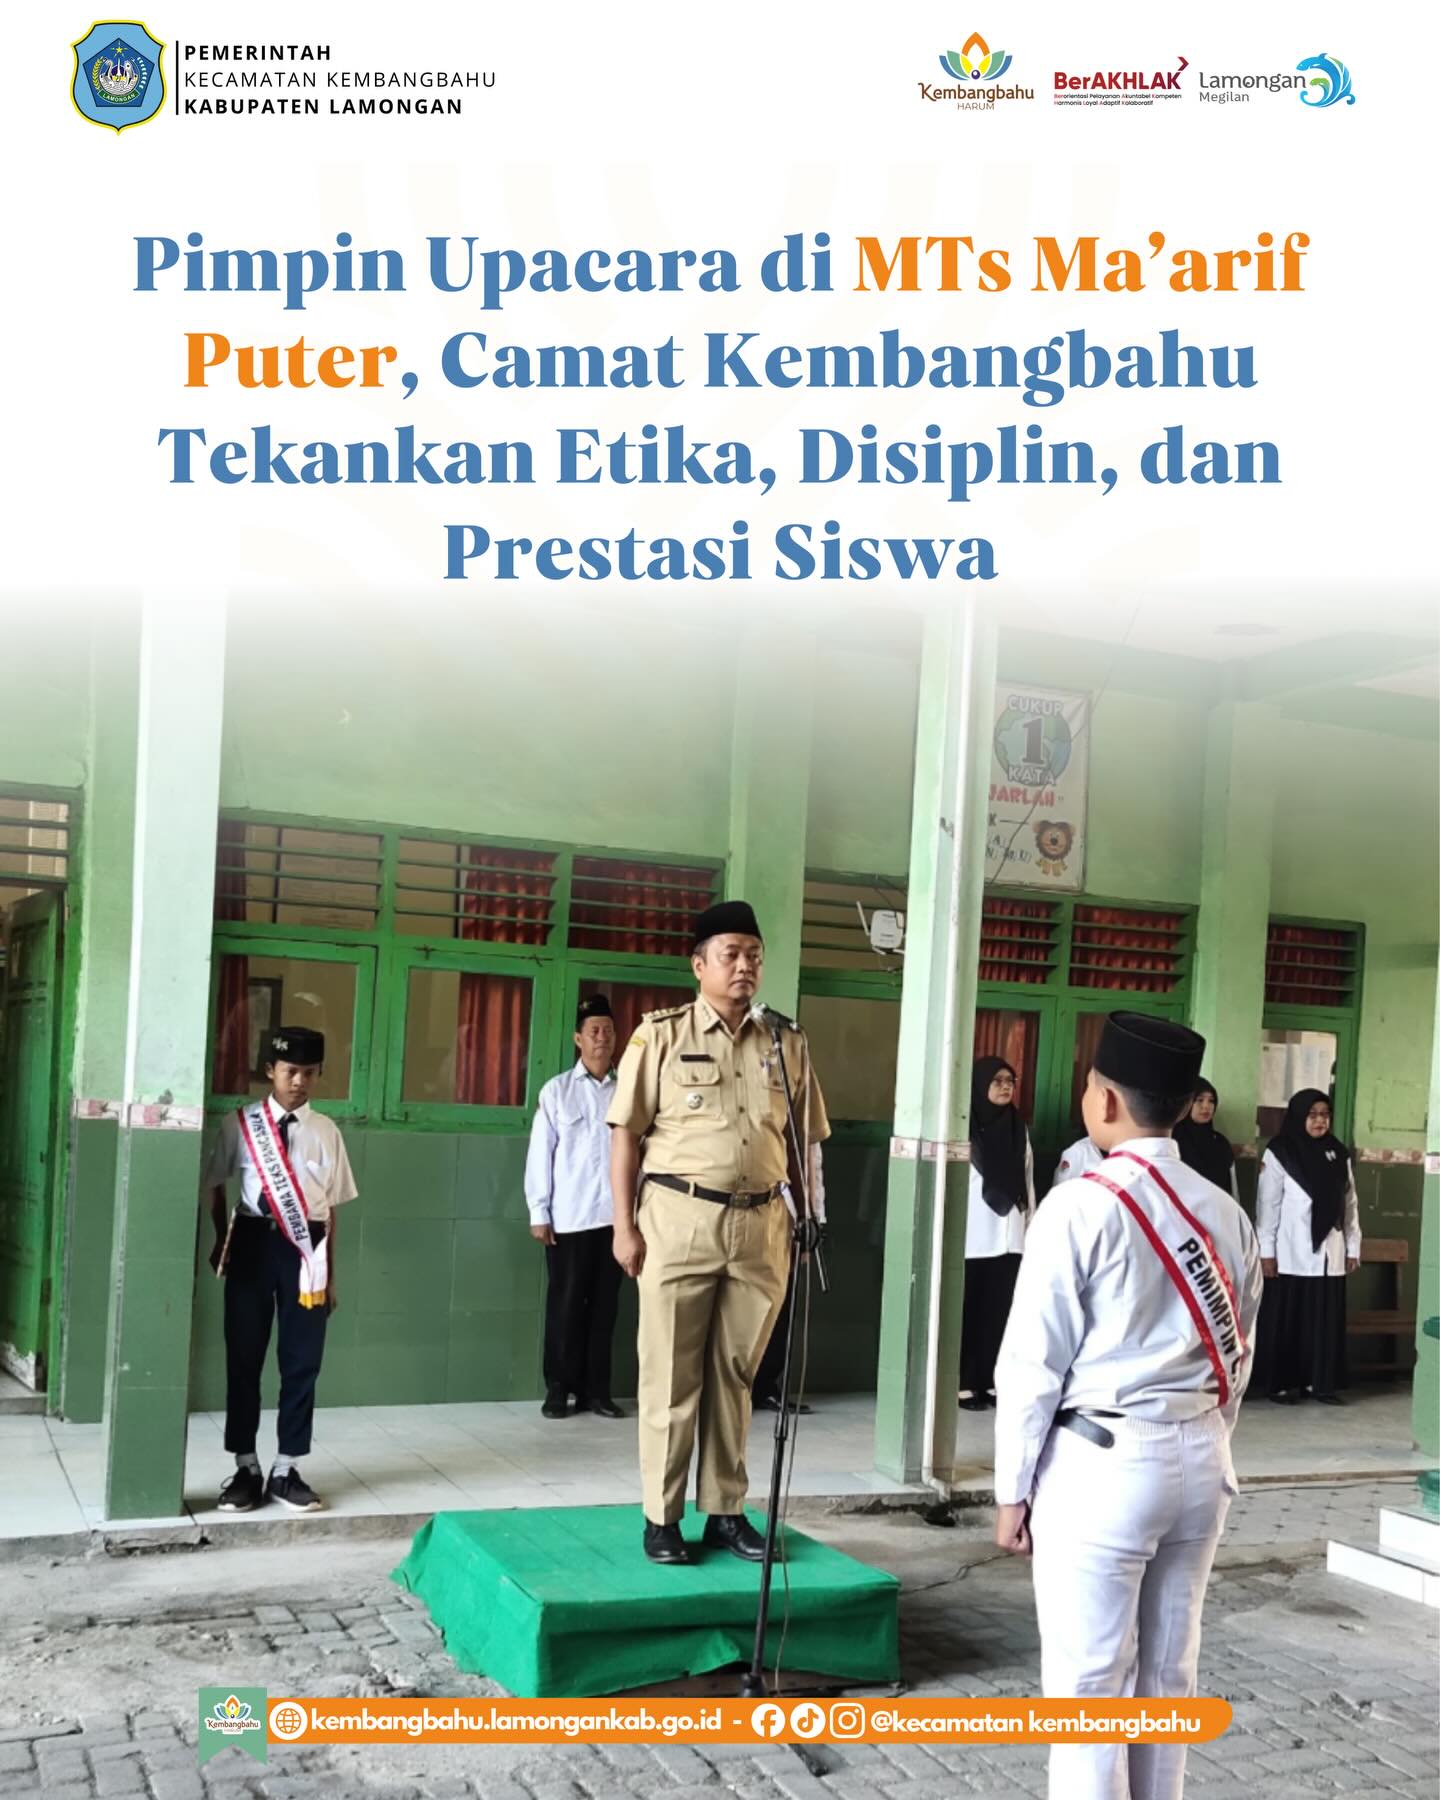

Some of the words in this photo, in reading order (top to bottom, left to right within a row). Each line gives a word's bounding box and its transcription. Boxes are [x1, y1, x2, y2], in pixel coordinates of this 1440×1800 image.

[1007, 694, 1064, 717] CUKUP
[1021, 716, 1045, 767] 1
[1007, 766, 1056, 786] KATA
[268, 1163, 289, 1192] TEKS
[279, 1190, 309, 1242] PEMBAWA
[1177, 1237, 1239, 1355] PEMIMPIN
